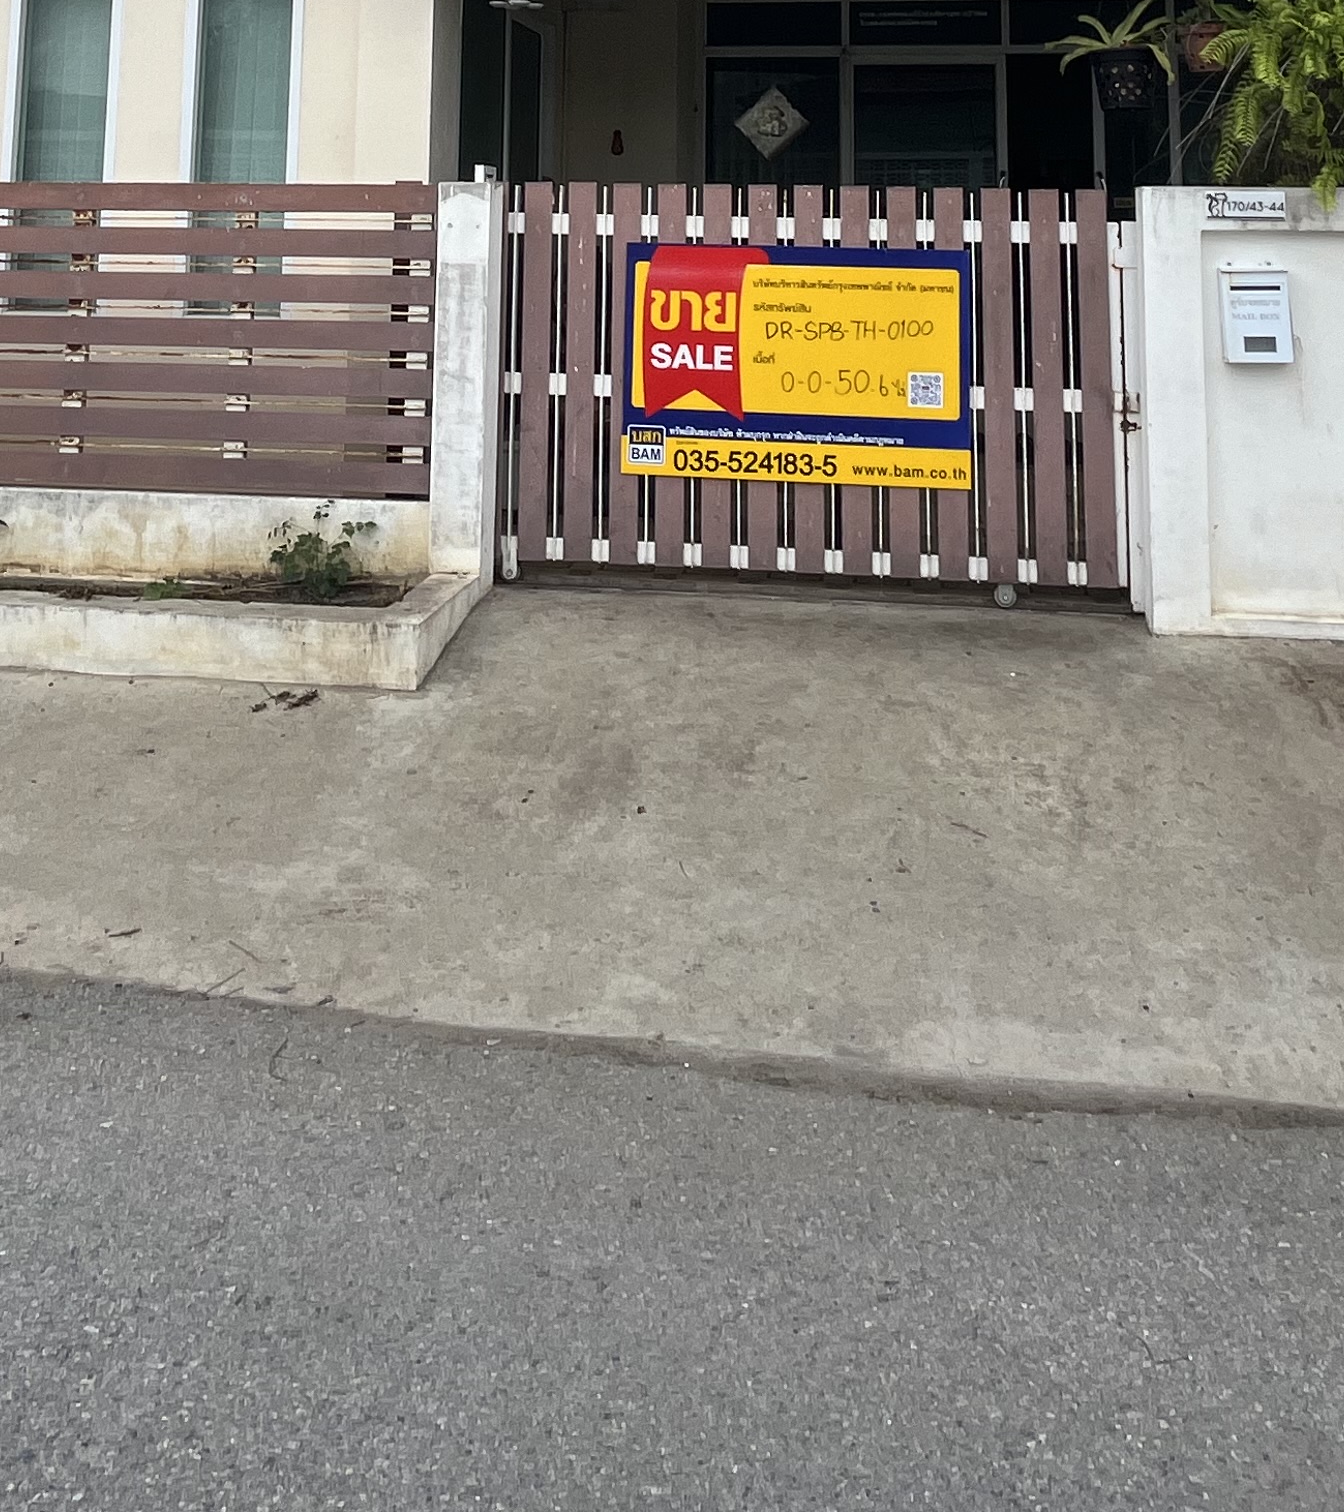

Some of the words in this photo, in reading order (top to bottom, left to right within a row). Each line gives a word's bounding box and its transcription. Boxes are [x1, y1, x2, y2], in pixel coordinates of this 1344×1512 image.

[1226, 201, 1285, 212] 170/43-44
[650, 289, 737, 332] ขาย
[650, 342, 734, 371] SALE
[631, 430, 662, 443] บสก
[631, 447, 661, 460] BAM
[673, 448, 838, 477] 035-524183-5
[852, 464, 967, 481] www.bam.co.th
